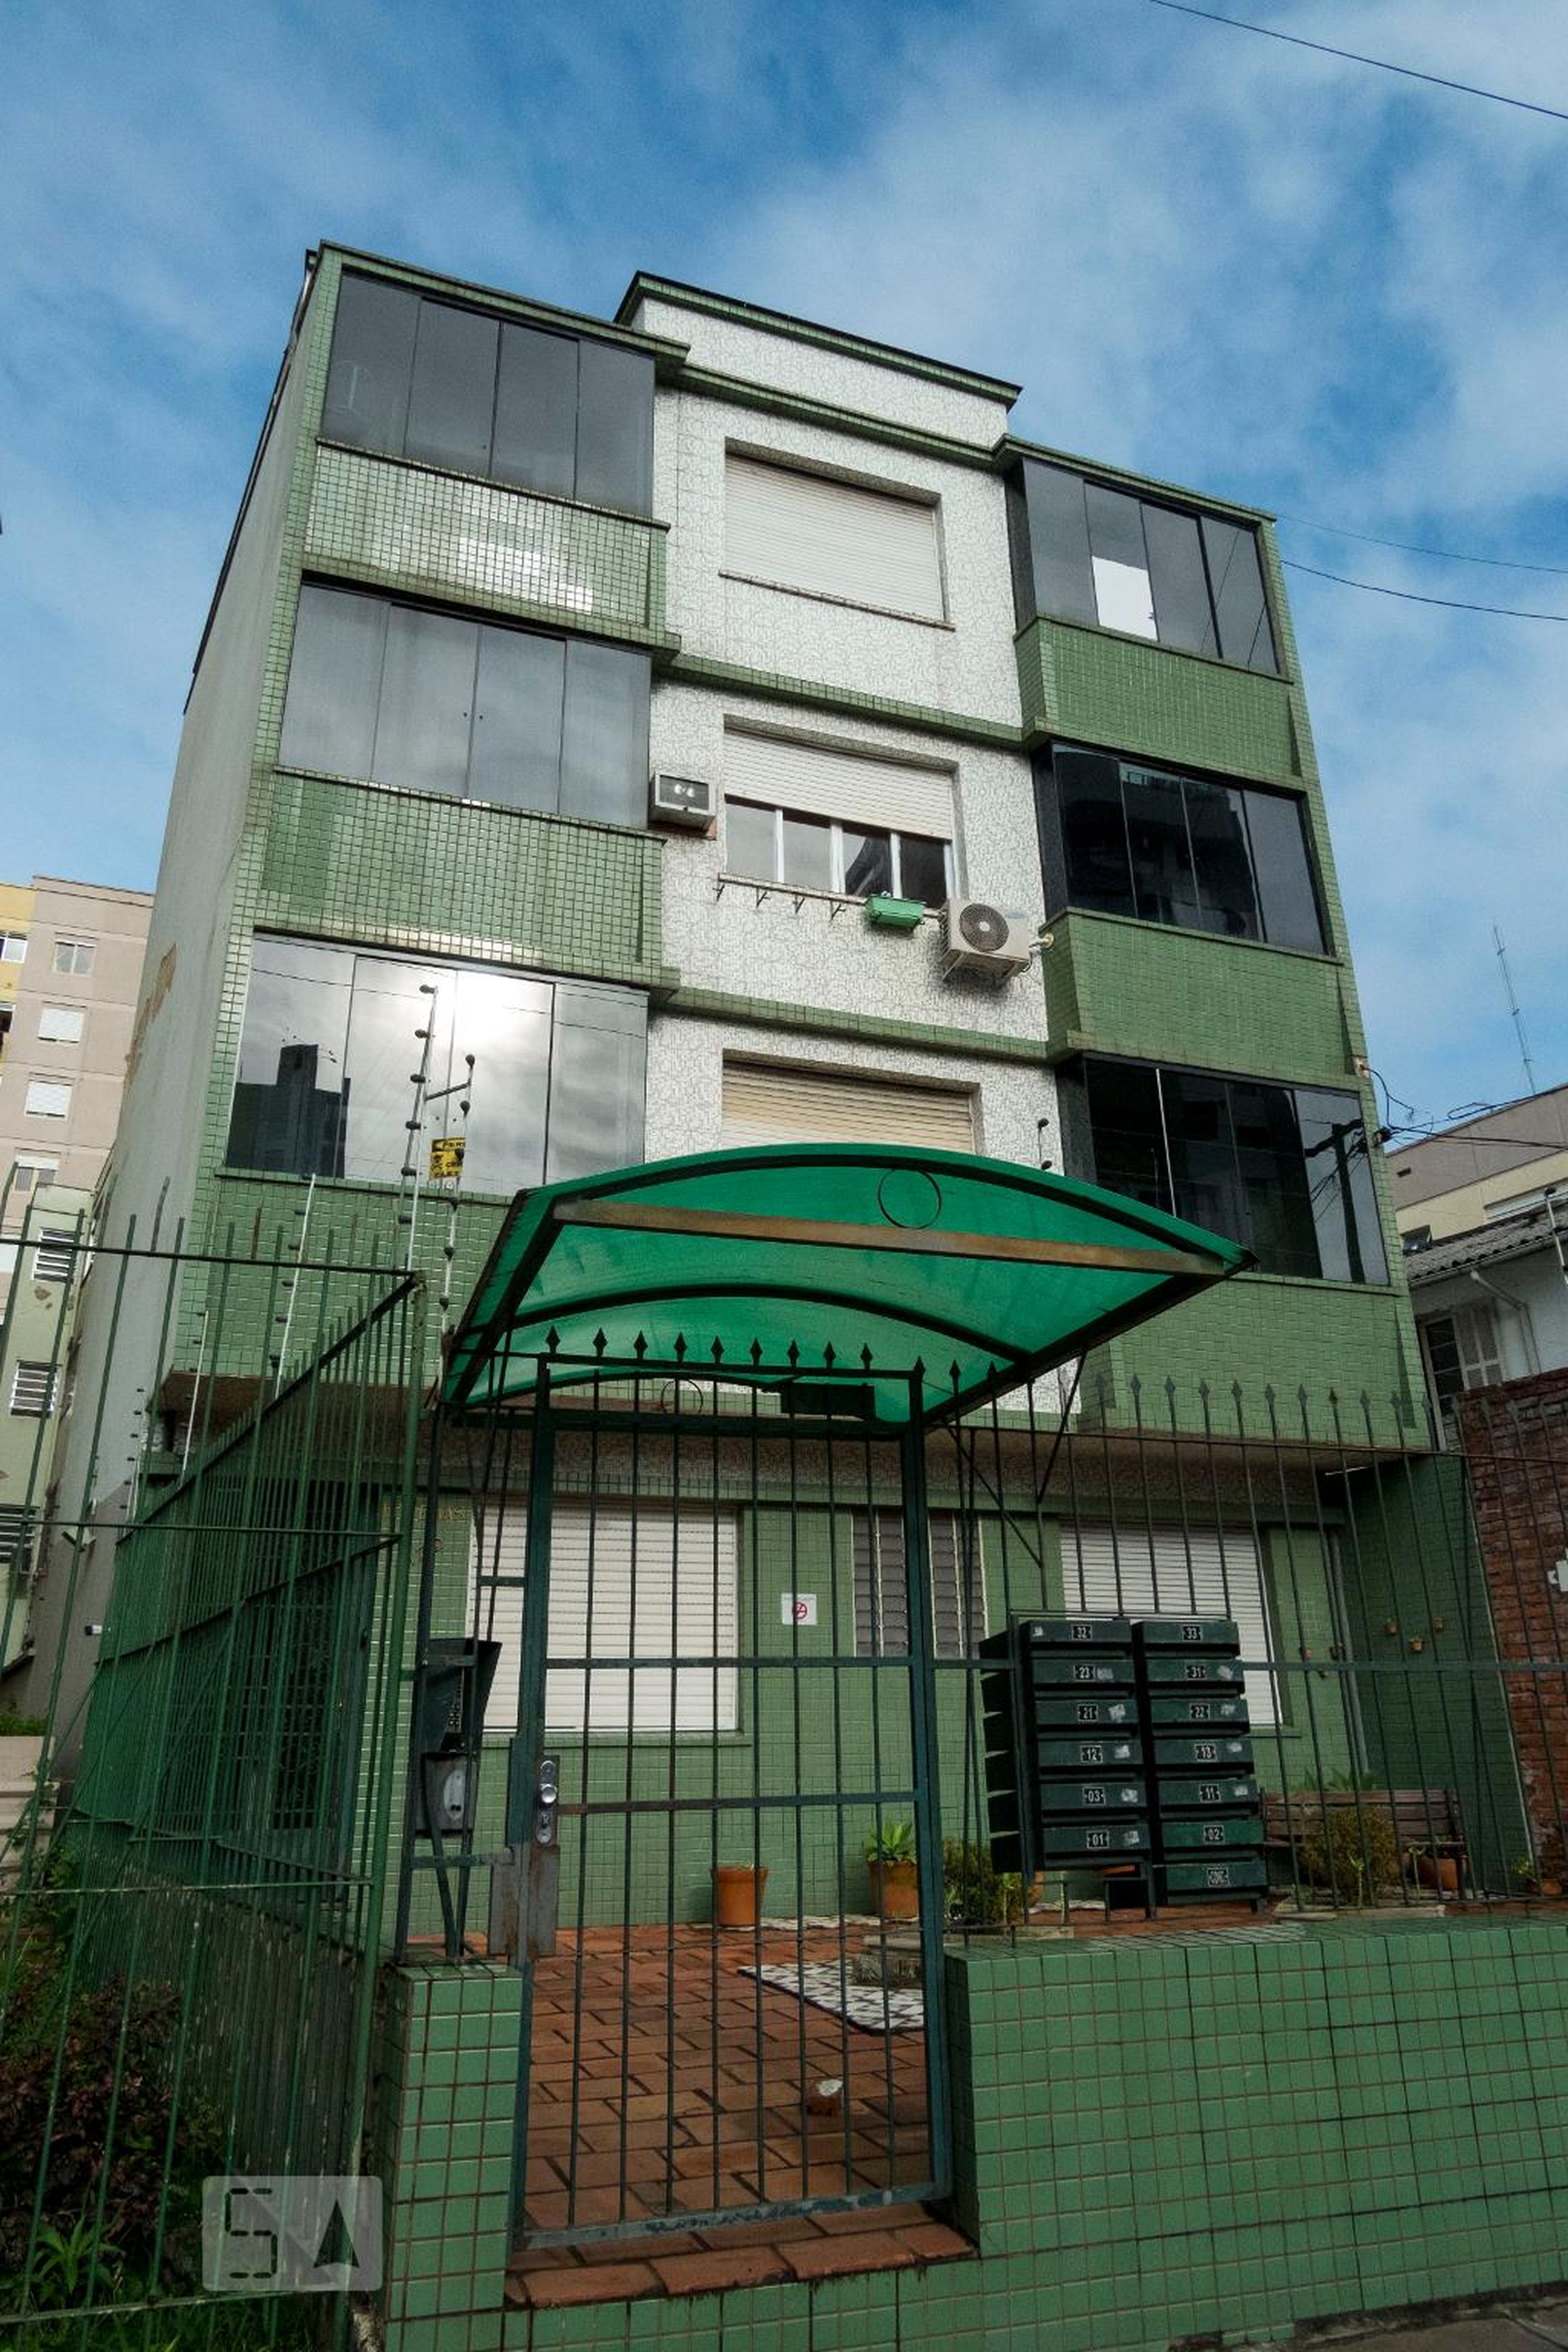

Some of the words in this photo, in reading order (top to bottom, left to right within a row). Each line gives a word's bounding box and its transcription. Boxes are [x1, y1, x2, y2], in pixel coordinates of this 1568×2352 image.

[1187, 1628, 1197, 1639] 33
[1079, 1667, 1089, 1678] 23
[1192, 1667, 1201, 1677] 31
[1083, 1707, 1093, 1719] 21
[1195, 1707, 1204, 1718] 22
[1087, 1748, 1097, 1760] 12
[1201, 1746, 1212, 1759] 13
[1088, 1791, 1100, 1802] 03
[1206, 1787, 1215, 1800] 11
[1093, 1834, 1103, 1845] 01
[1208, 1829, 1219, 1840] 02
